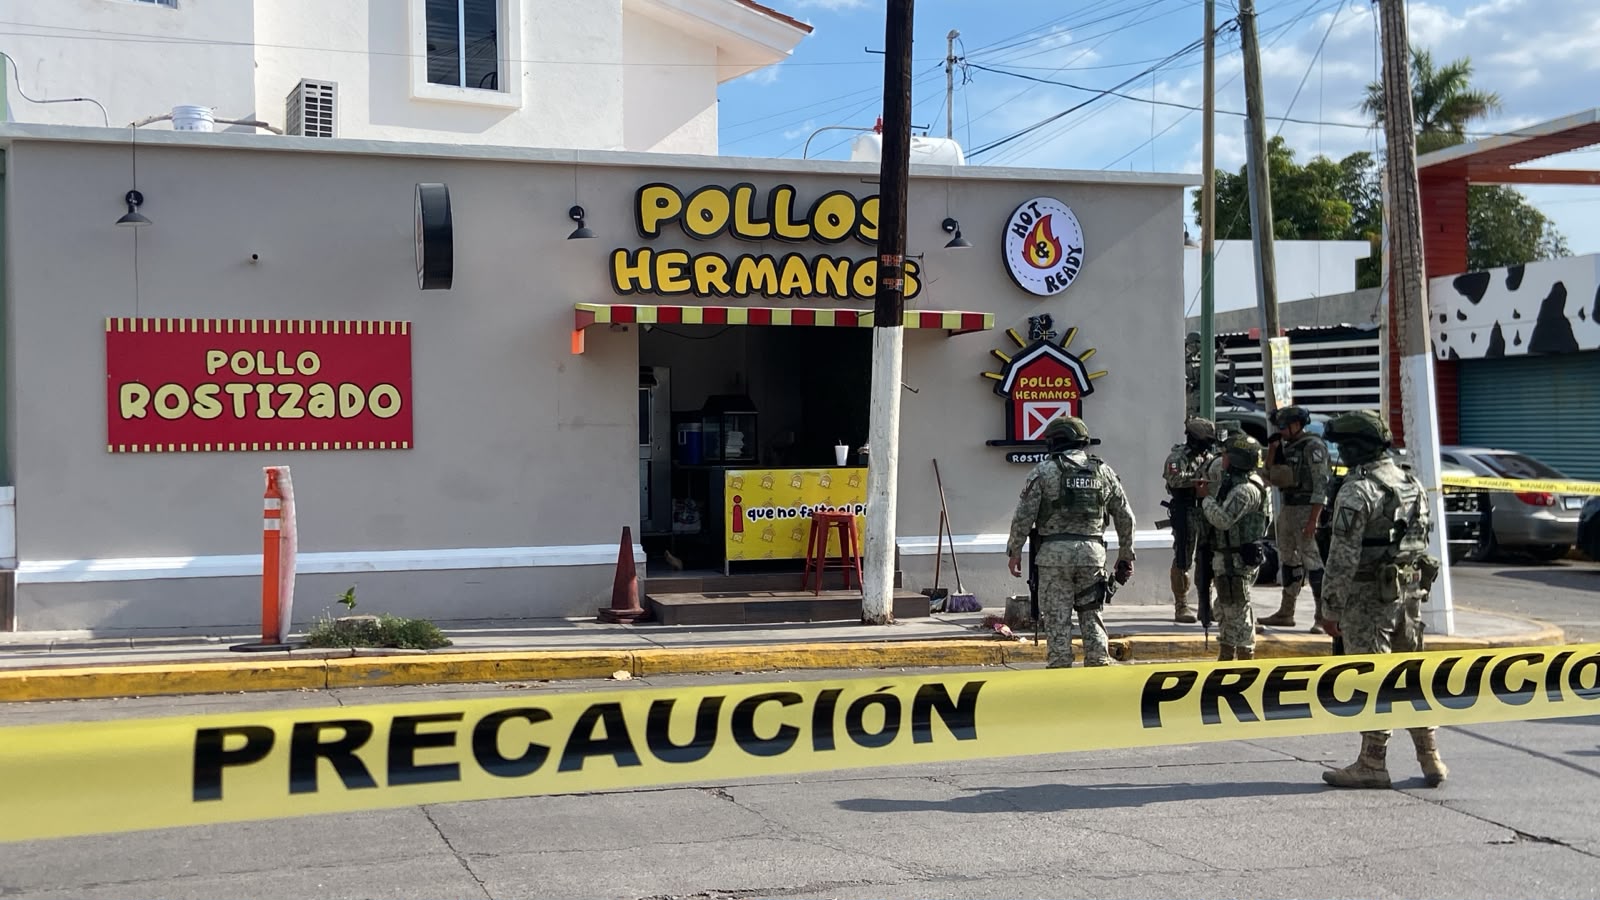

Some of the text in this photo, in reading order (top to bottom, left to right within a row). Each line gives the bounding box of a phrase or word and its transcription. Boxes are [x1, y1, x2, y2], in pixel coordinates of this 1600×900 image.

[1011, 201, 1042, 239] HOT
[1035, 241, 1050, 258] &
[1044, 244, 1083, 293] READY
[206, 350, 321, 375] POLLO
[1020, 377, 1072, 387] POLLOS
[1015, 391, 1077, 400] HERMANOS
[747, 508, 774, 521] que
[777, 508, 797, 518] no
[192, 680, 987, 801] PRECAUCIÓN
